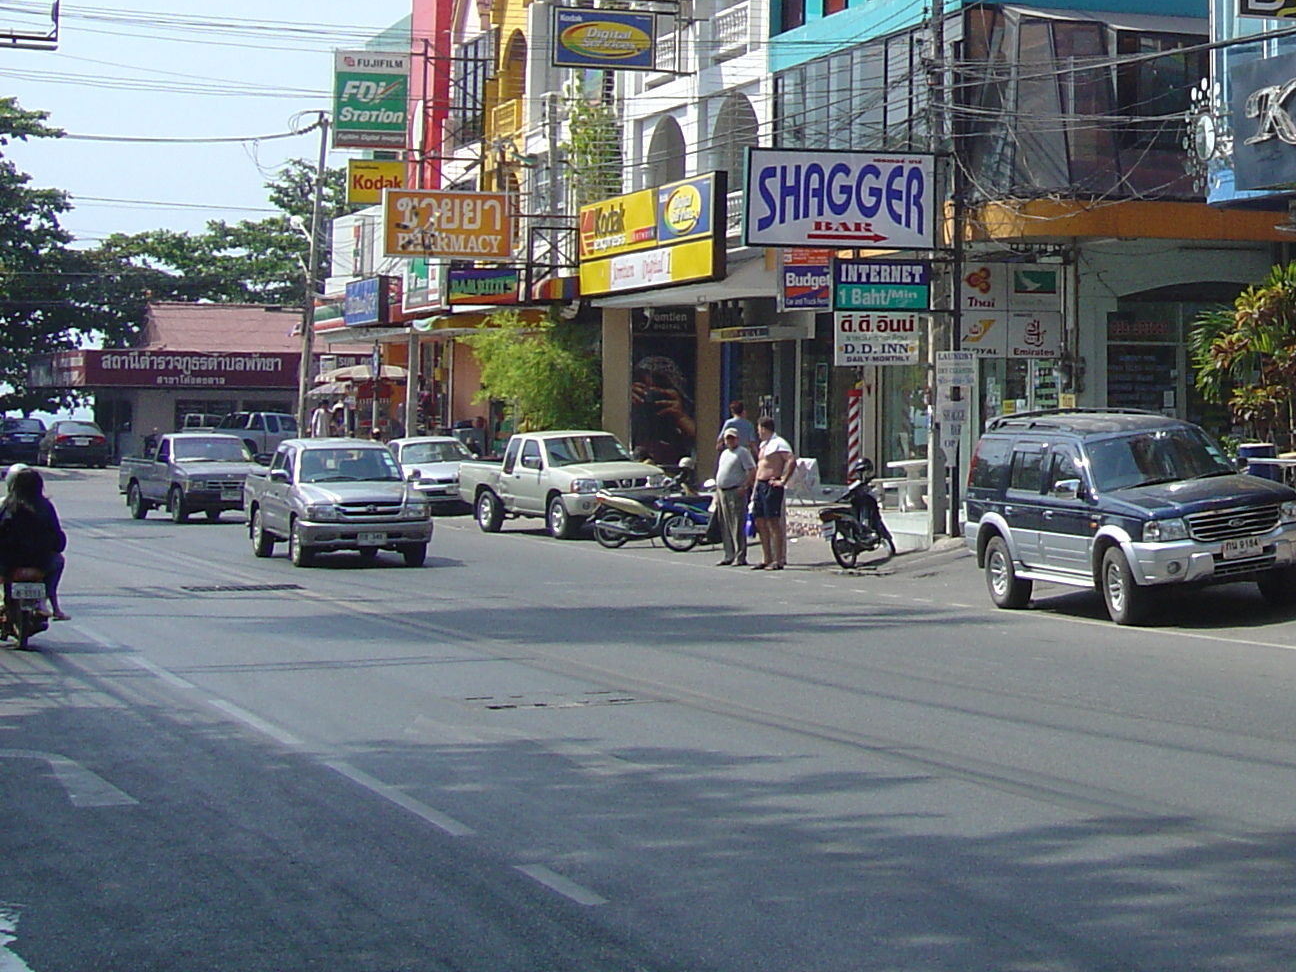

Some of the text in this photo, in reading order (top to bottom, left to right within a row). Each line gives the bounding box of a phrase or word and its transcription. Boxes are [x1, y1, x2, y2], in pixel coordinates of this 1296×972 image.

[560, 13, 583, 22] Kodak
[586, 27, 633, 40] Digital
[357, 58, 403, 69] FUJIFILM
[353, 174, 403, 191] Kodak
[757, 162, 925, 236] SHAGGER
[594, 201, 626, 239] Kodak
[812, 220, 875, 233] BAR
[396, 232, 502, 254] PHARMACY
[840, 263, 924, 283] INTERNET
[785, 271, 831, 290] Budget
[838, 290, 846, 305] 1
[967, 296, 995, 308] Thai
[843, 343, 909, 354] D.D. INN
[1013, 347, 1055, 356] Emirates
[937, 353, 974, 361] LAUNDRY
